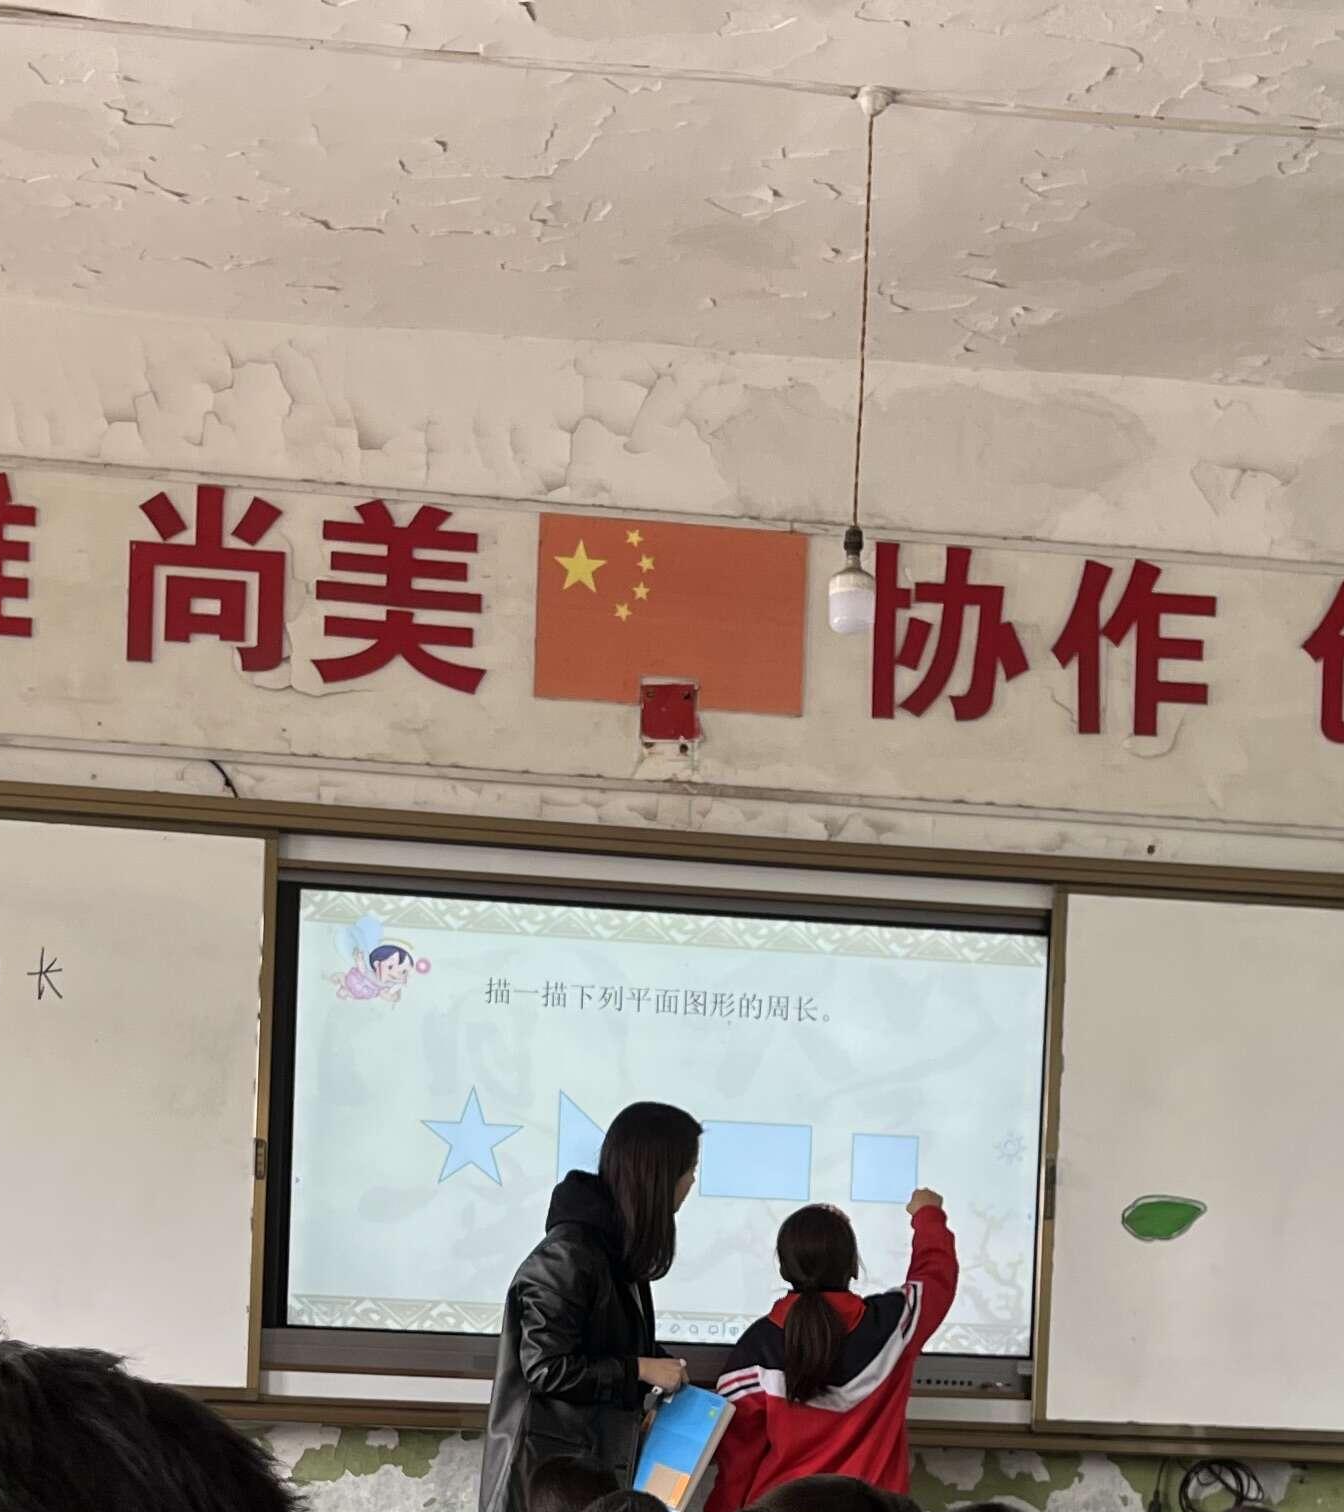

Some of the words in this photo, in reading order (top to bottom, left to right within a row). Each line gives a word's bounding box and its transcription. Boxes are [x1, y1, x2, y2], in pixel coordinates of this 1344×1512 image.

[127, 485, 485, 693] 尚美
[870, 541, 1217, 736] 协作
[485, 976, 833, 1024] 描一描下列平面图形的周长。
